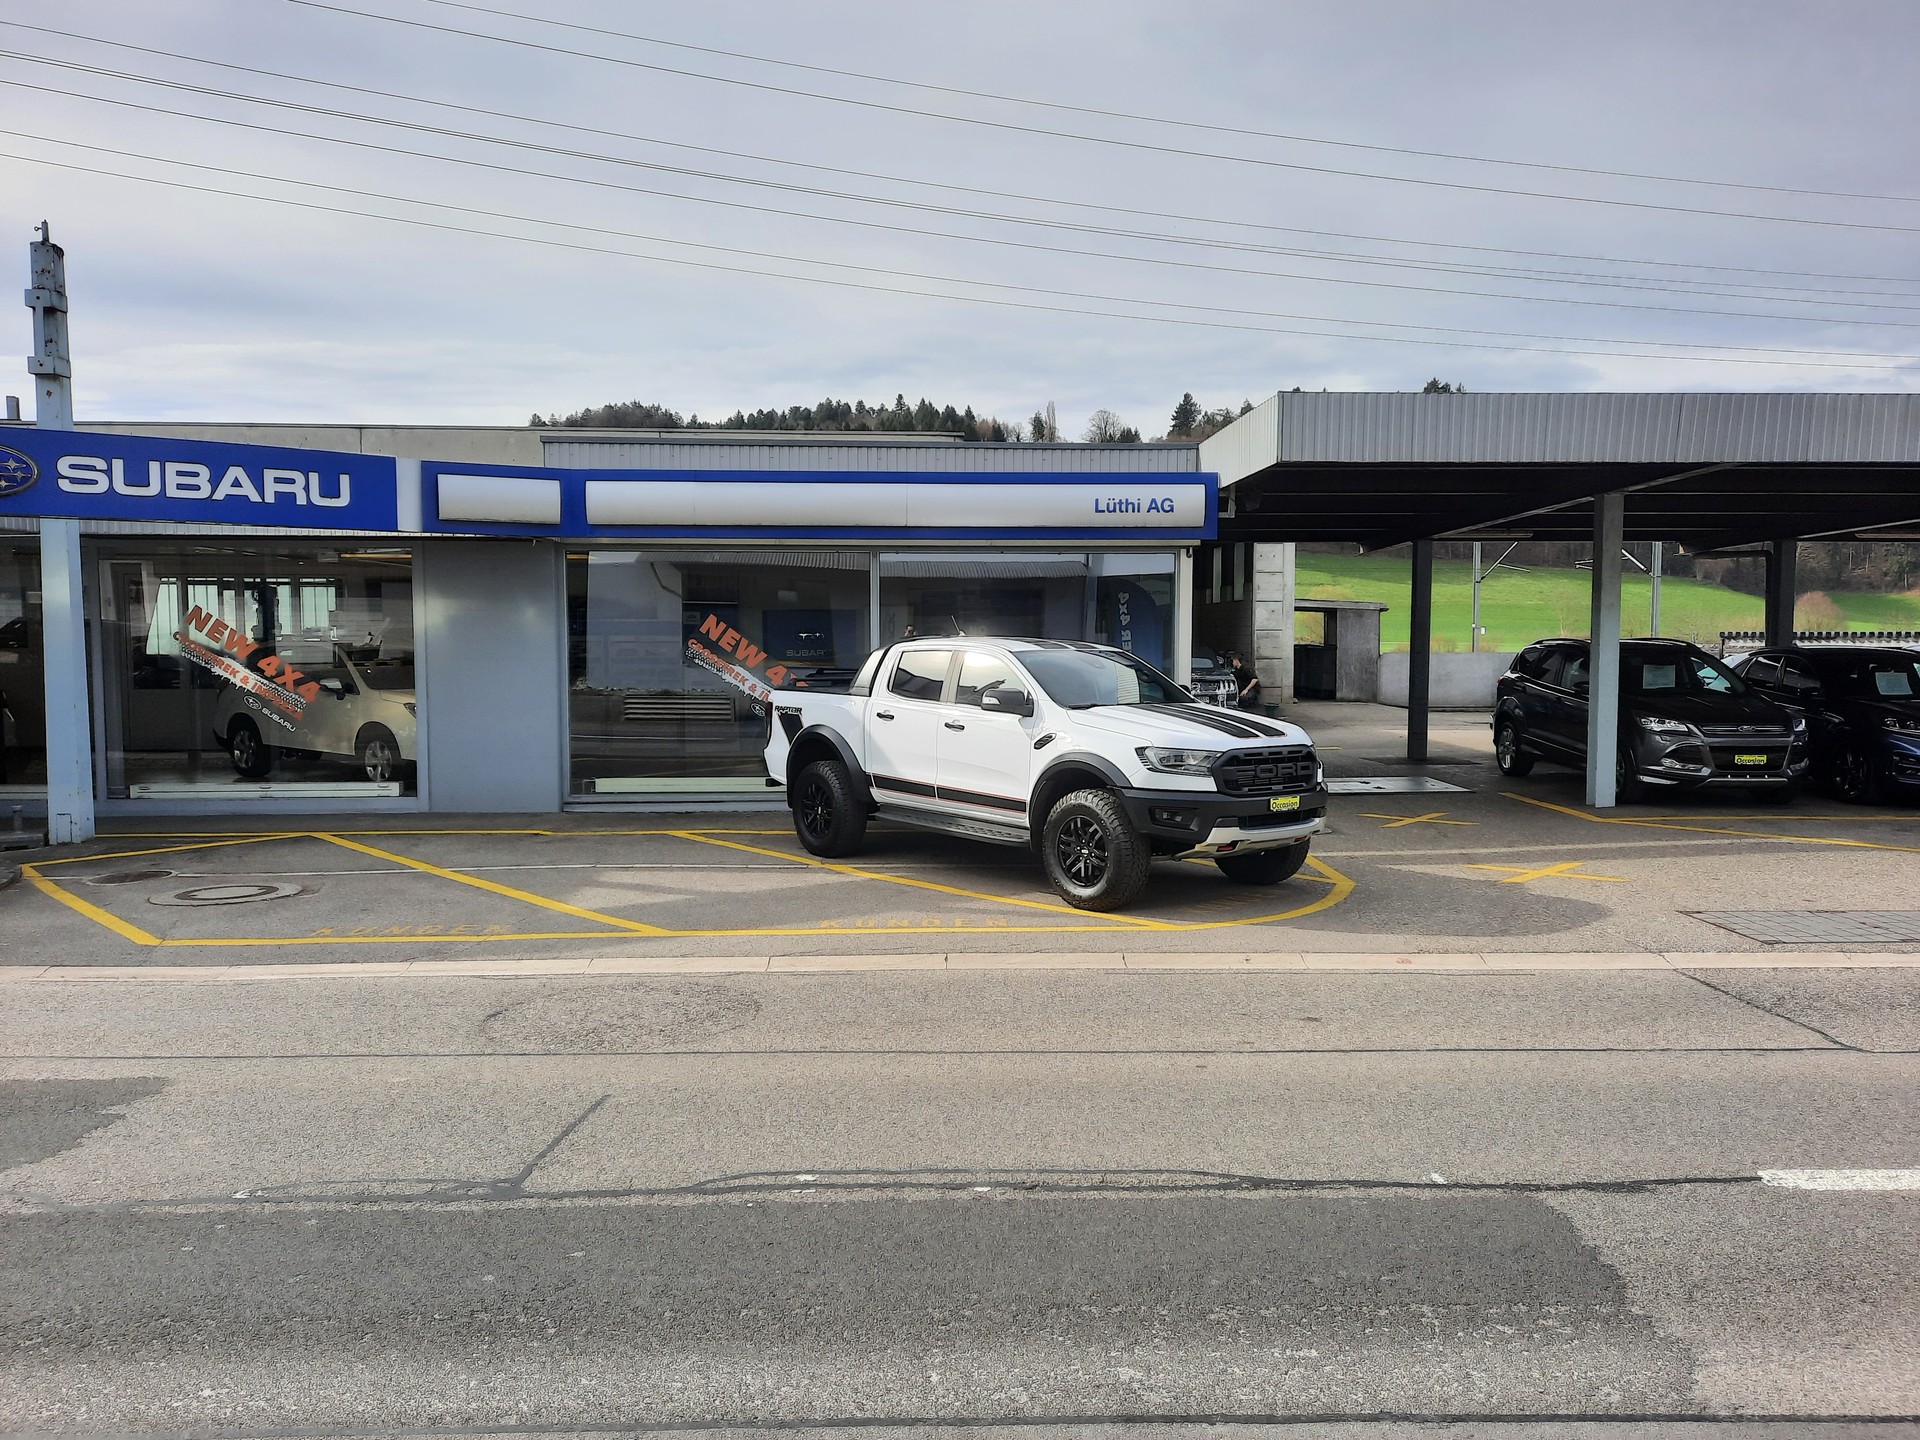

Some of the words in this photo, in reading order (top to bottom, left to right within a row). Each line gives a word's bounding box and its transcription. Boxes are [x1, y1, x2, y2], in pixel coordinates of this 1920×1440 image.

[56, 455, 350, 507] SUBARU
[1094, 497, 1141, 514] Lüthi
[1146, 497, 1175, 514] AG
[185, 604, 260, 660] NEW
[699, 613, 768, 669] NEW
[786, 649, 832, 658] SUBAR
[774, 705, 803, 715] RAPTOR
[261, 707, 297, 733] SUBARU
[1232, 761, 1314, 780] FORD
[1271, 800, 1299, 810] Occasion
